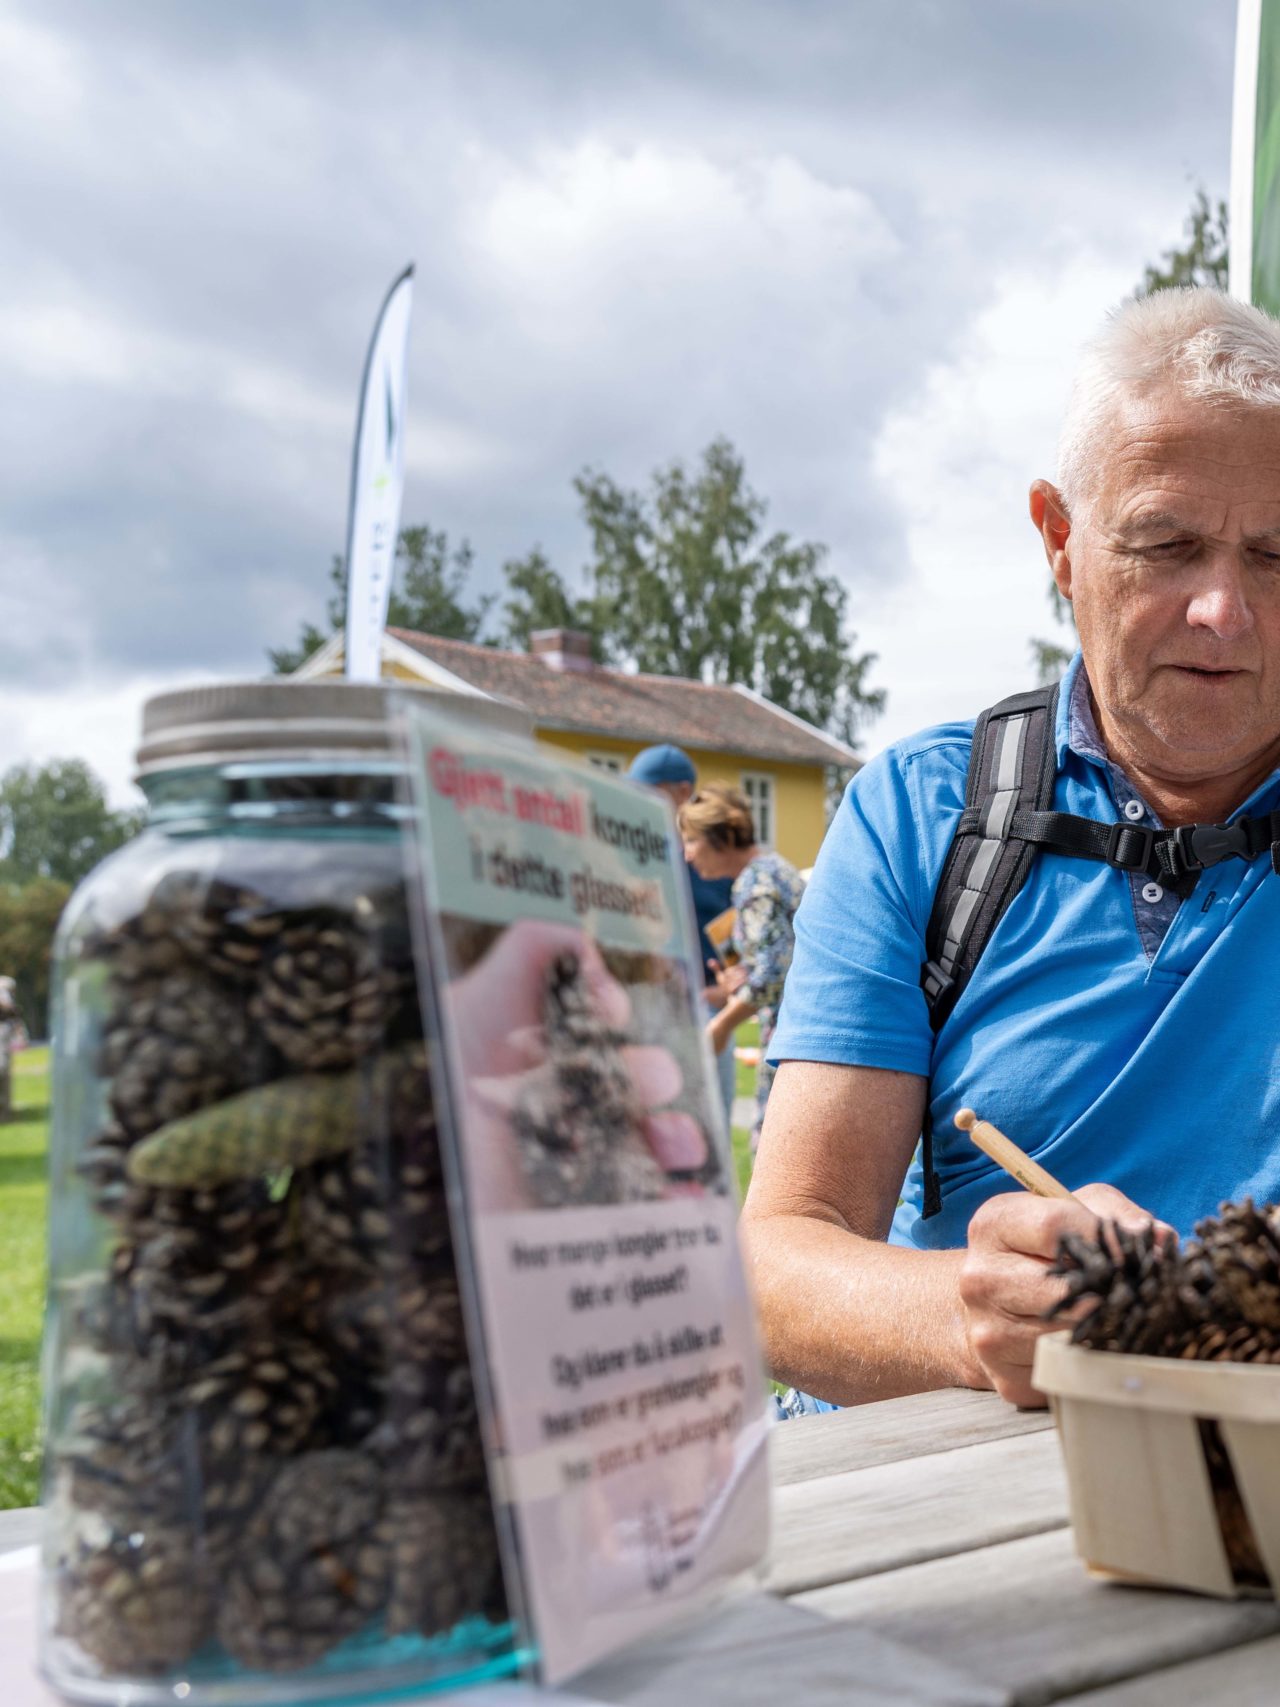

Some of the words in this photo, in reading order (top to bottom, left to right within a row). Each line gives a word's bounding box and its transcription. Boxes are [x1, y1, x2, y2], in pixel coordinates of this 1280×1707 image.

[428, 745, 508, 814] Gjett
[513, 784, 585, 836] antall
[590, 800, 670, 864] kongler
[488, 844, 564, 899] dette
